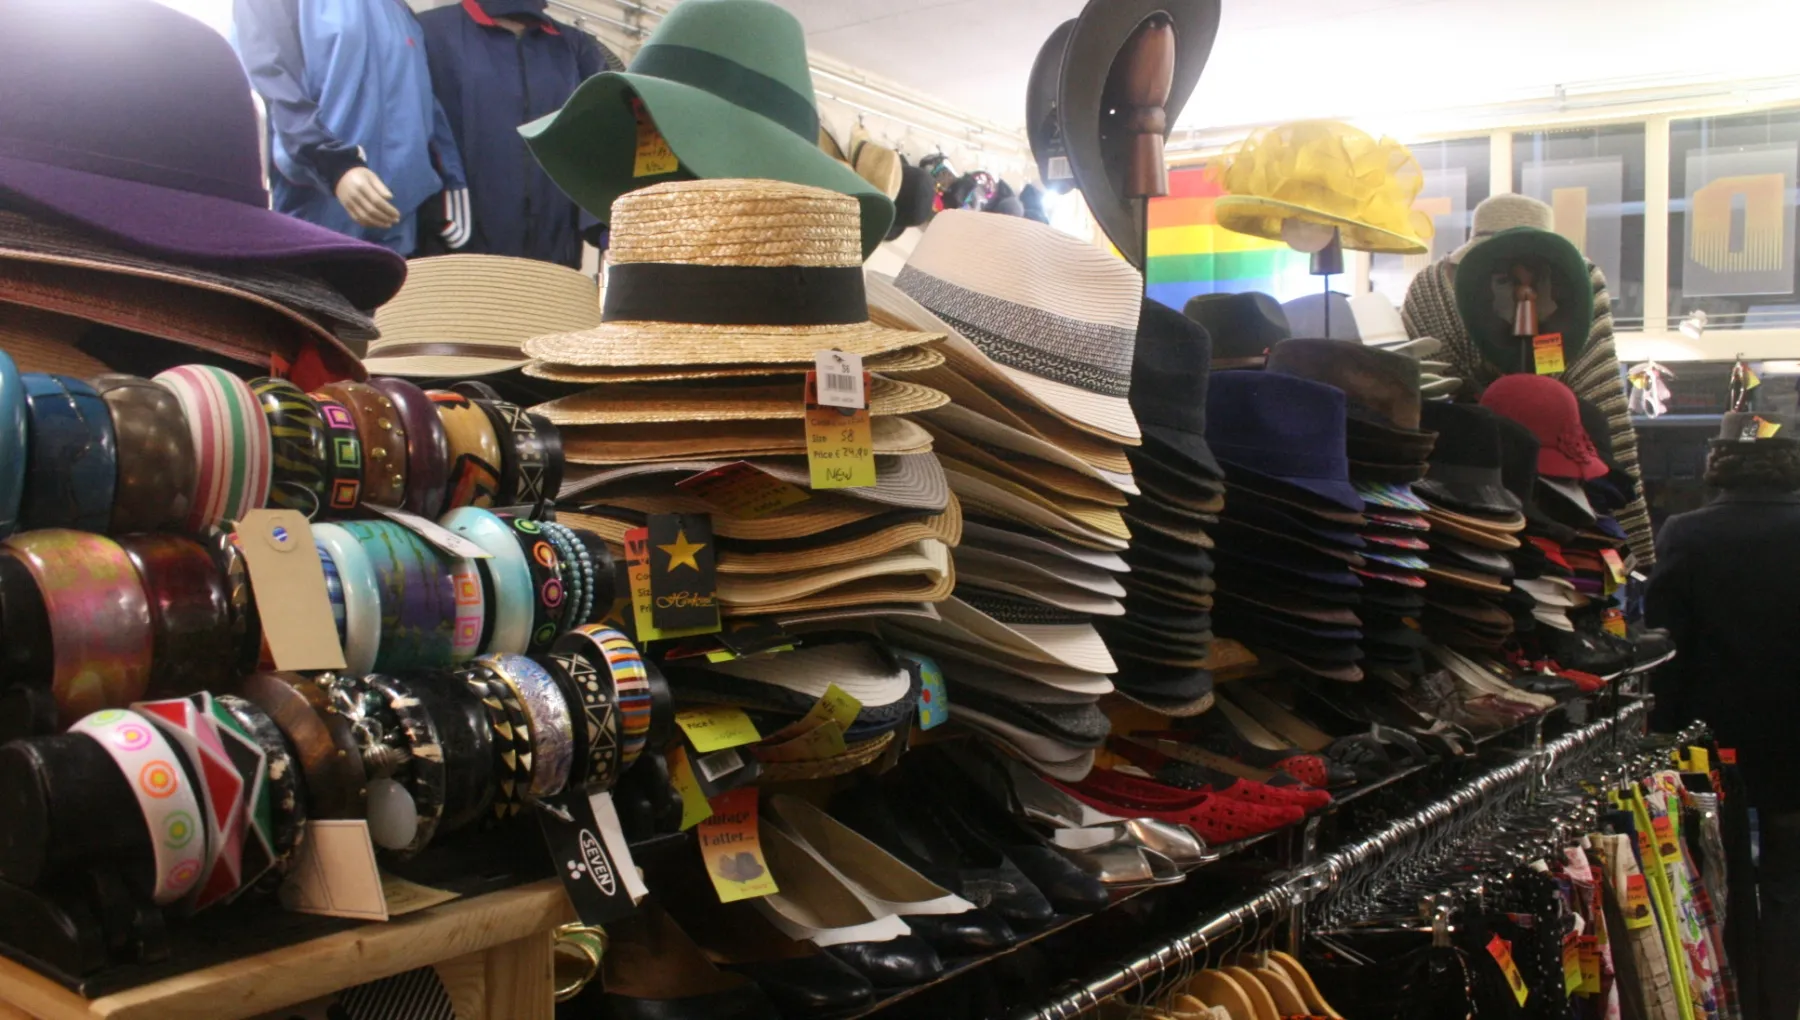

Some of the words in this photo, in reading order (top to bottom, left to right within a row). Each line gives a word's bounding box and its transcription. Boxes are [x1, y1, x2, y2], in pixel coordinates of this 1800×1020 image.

[812, 434, 828, 443] Size
[813, 449, 833, 459] Price
[825, 466, 853, 482] NEW
[583, 838, 612, 886] SEVEN
